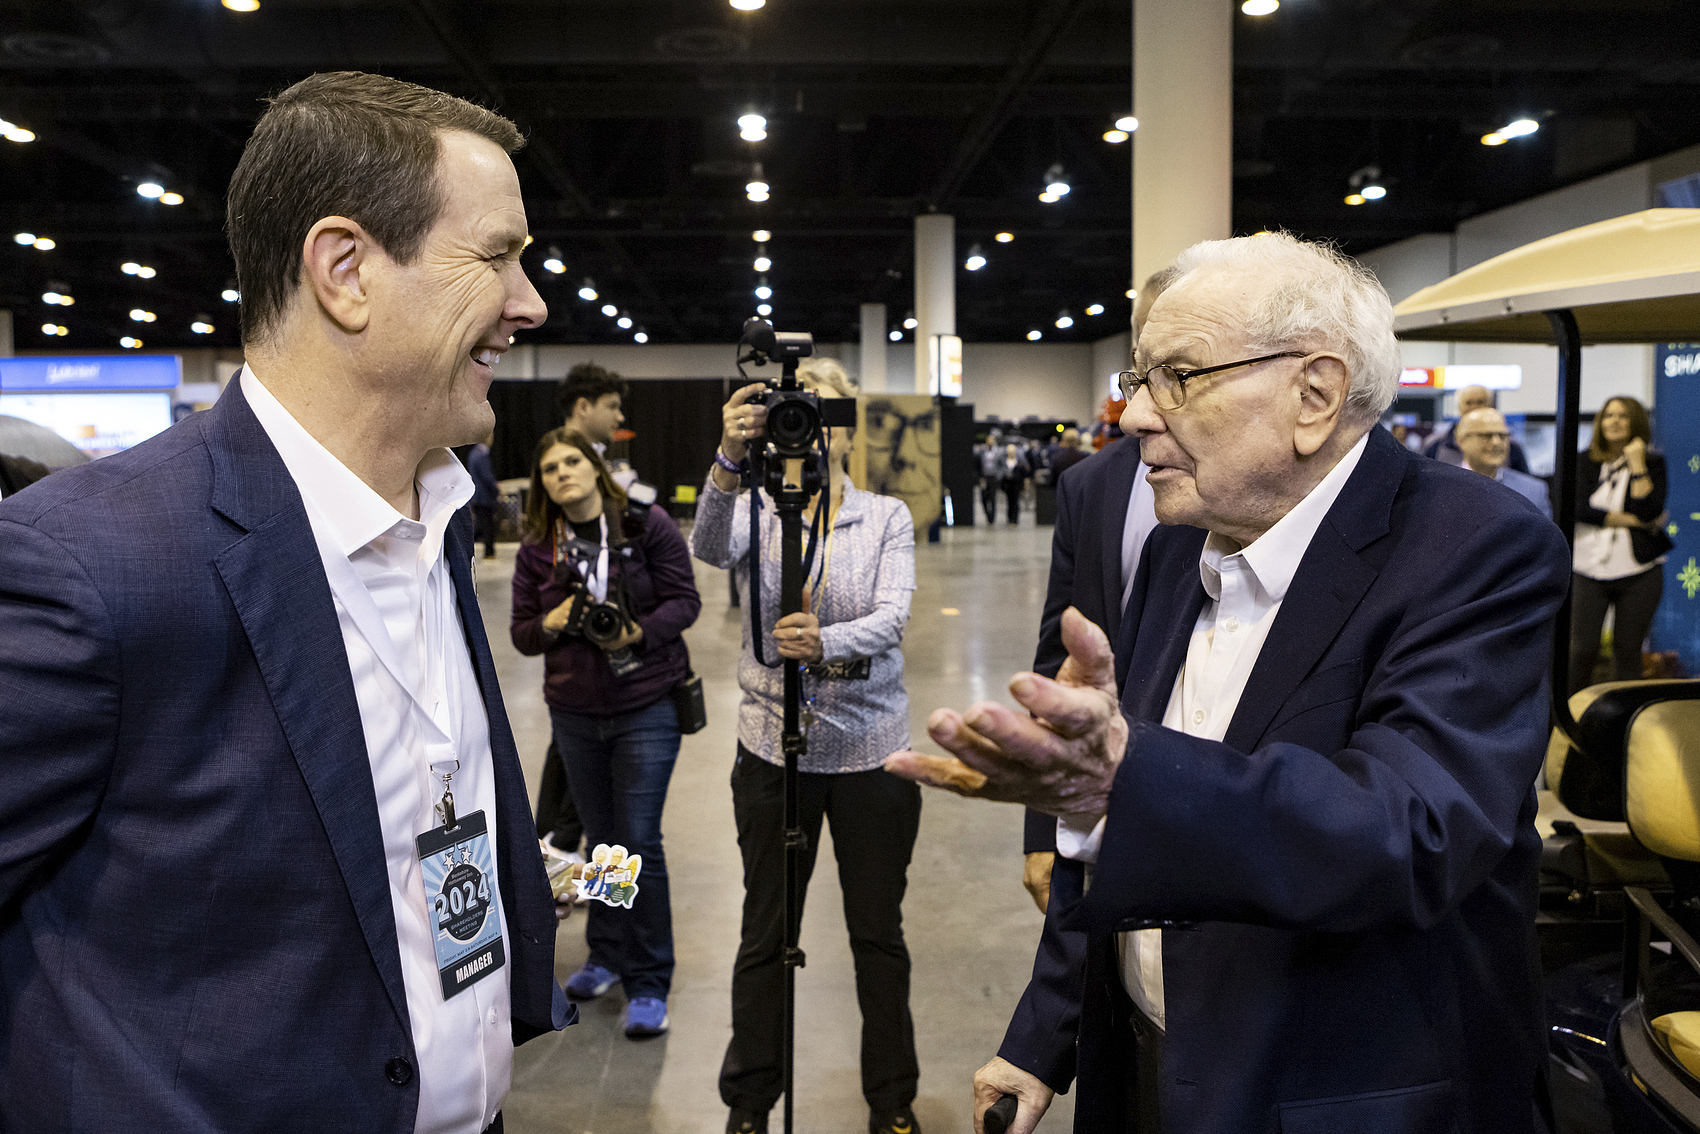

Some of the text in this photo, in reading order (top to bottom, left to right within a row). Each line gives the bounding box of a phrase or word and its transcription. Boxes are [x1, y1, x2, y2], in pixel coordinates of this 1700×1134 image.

[435, 872, 491, 924] 2024
[450, 910, 484, 930] SHAREHOLDERS
[455, 951, 493, 984] MANAGER
